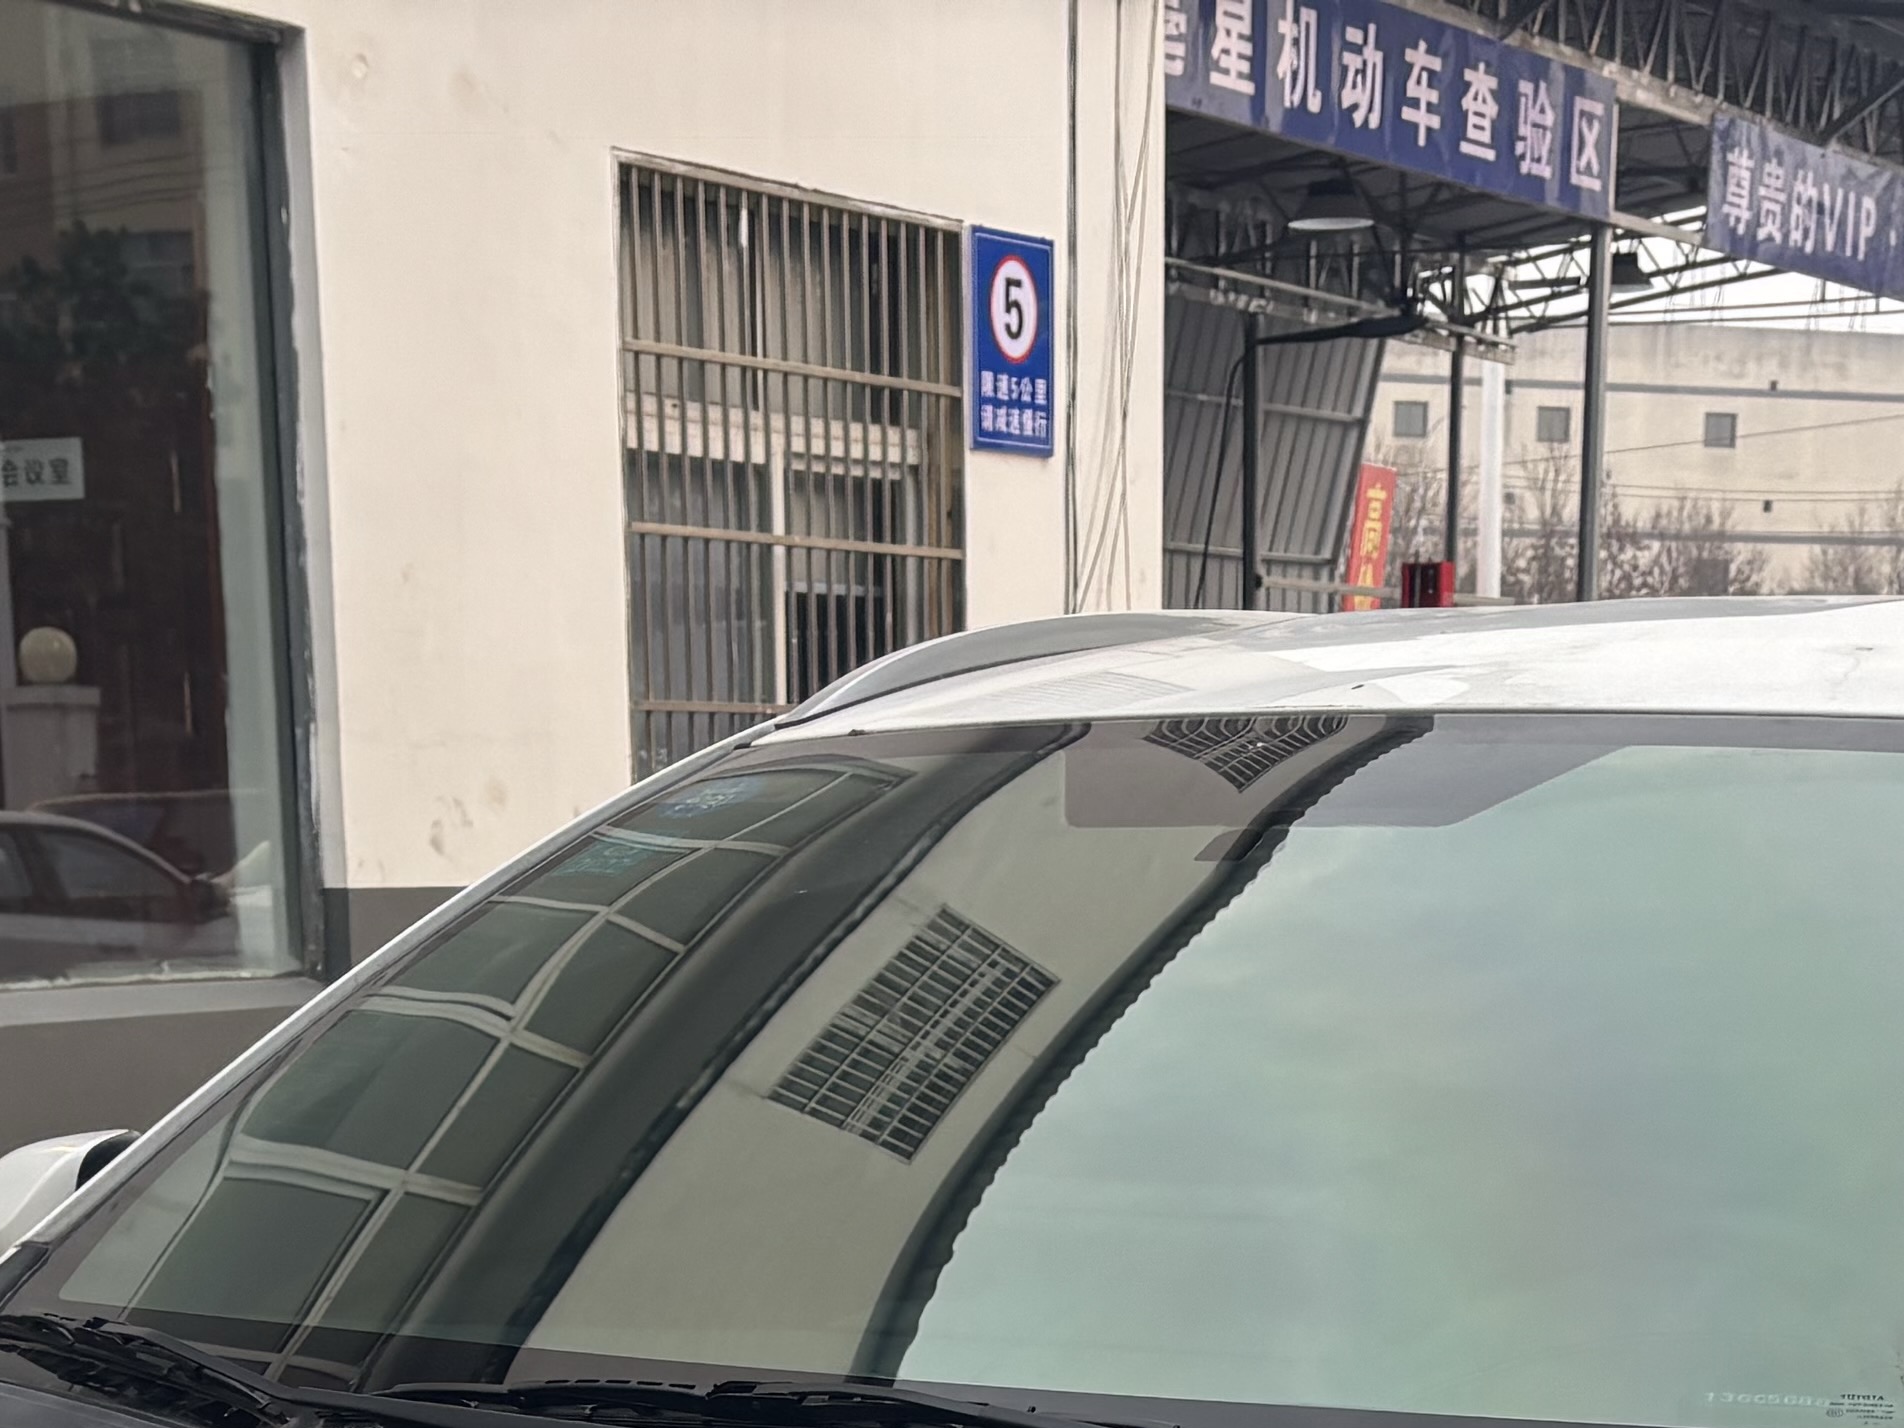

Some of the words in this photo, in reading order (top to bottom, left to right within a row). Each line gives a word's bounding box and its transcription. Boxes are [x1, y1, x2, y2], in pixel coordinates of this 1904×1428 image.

[1005, 277, 1023, 339] 5
[981, 370, 1047, 405] 限速5公里
[1, 458, 72, 487] 会议室
